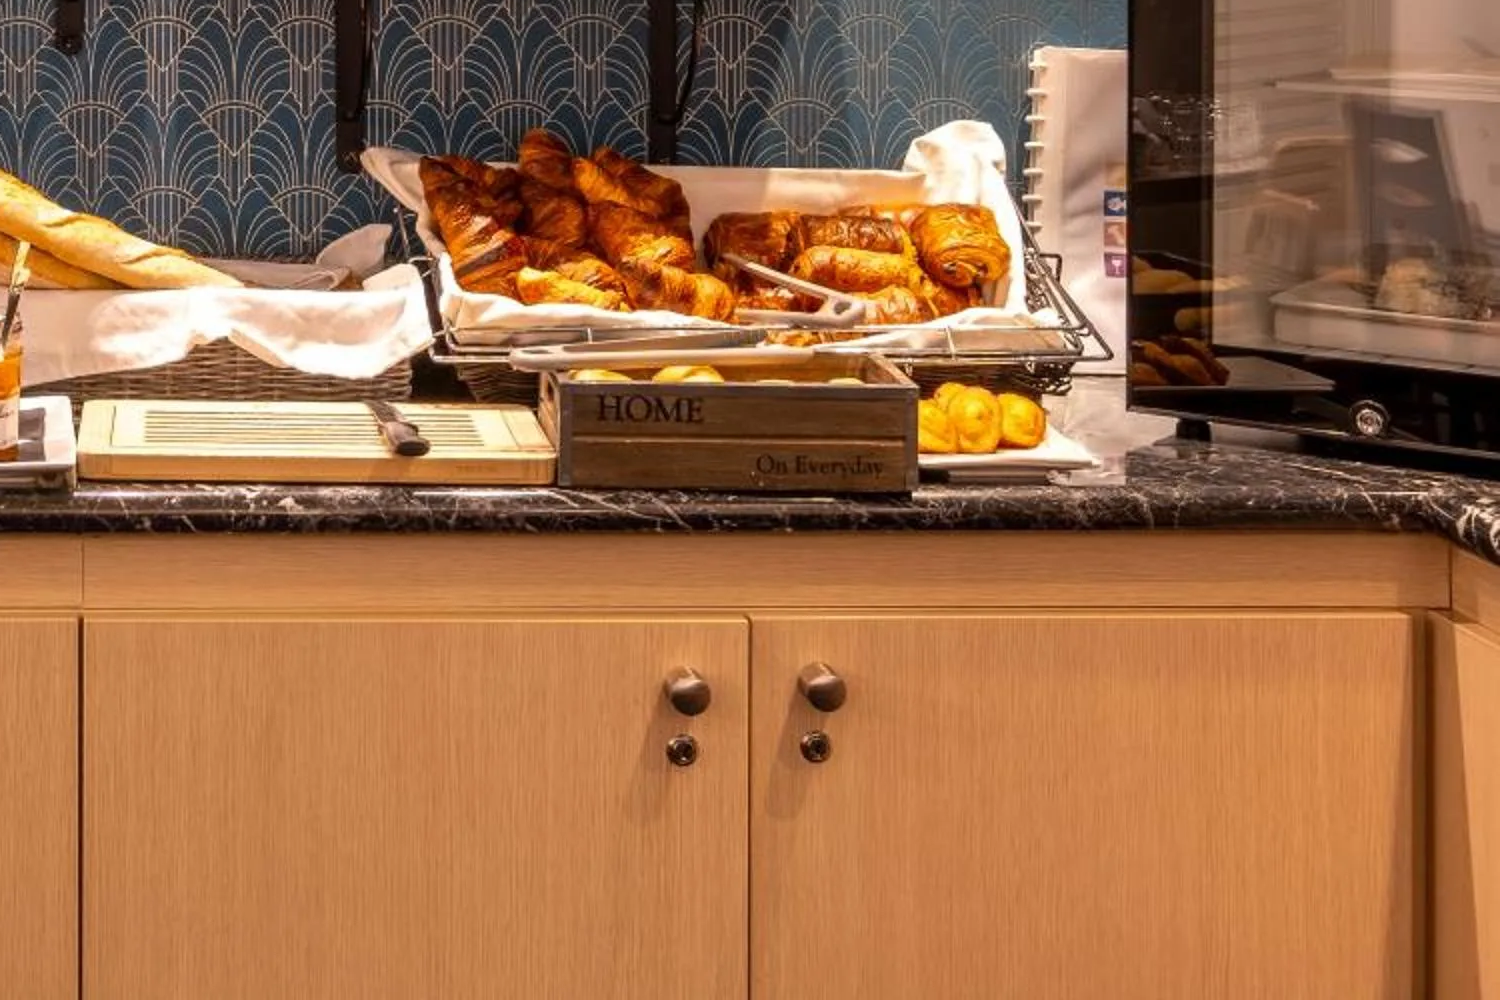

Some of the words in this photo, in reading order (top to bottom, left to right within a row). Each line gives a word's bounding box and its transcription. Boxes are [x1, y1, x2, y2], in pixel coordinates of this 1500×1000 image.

[597, 395, 705, 423] HOME
[756, 454, 788, 475] On
[795, 454, 884, 479] Everyday
